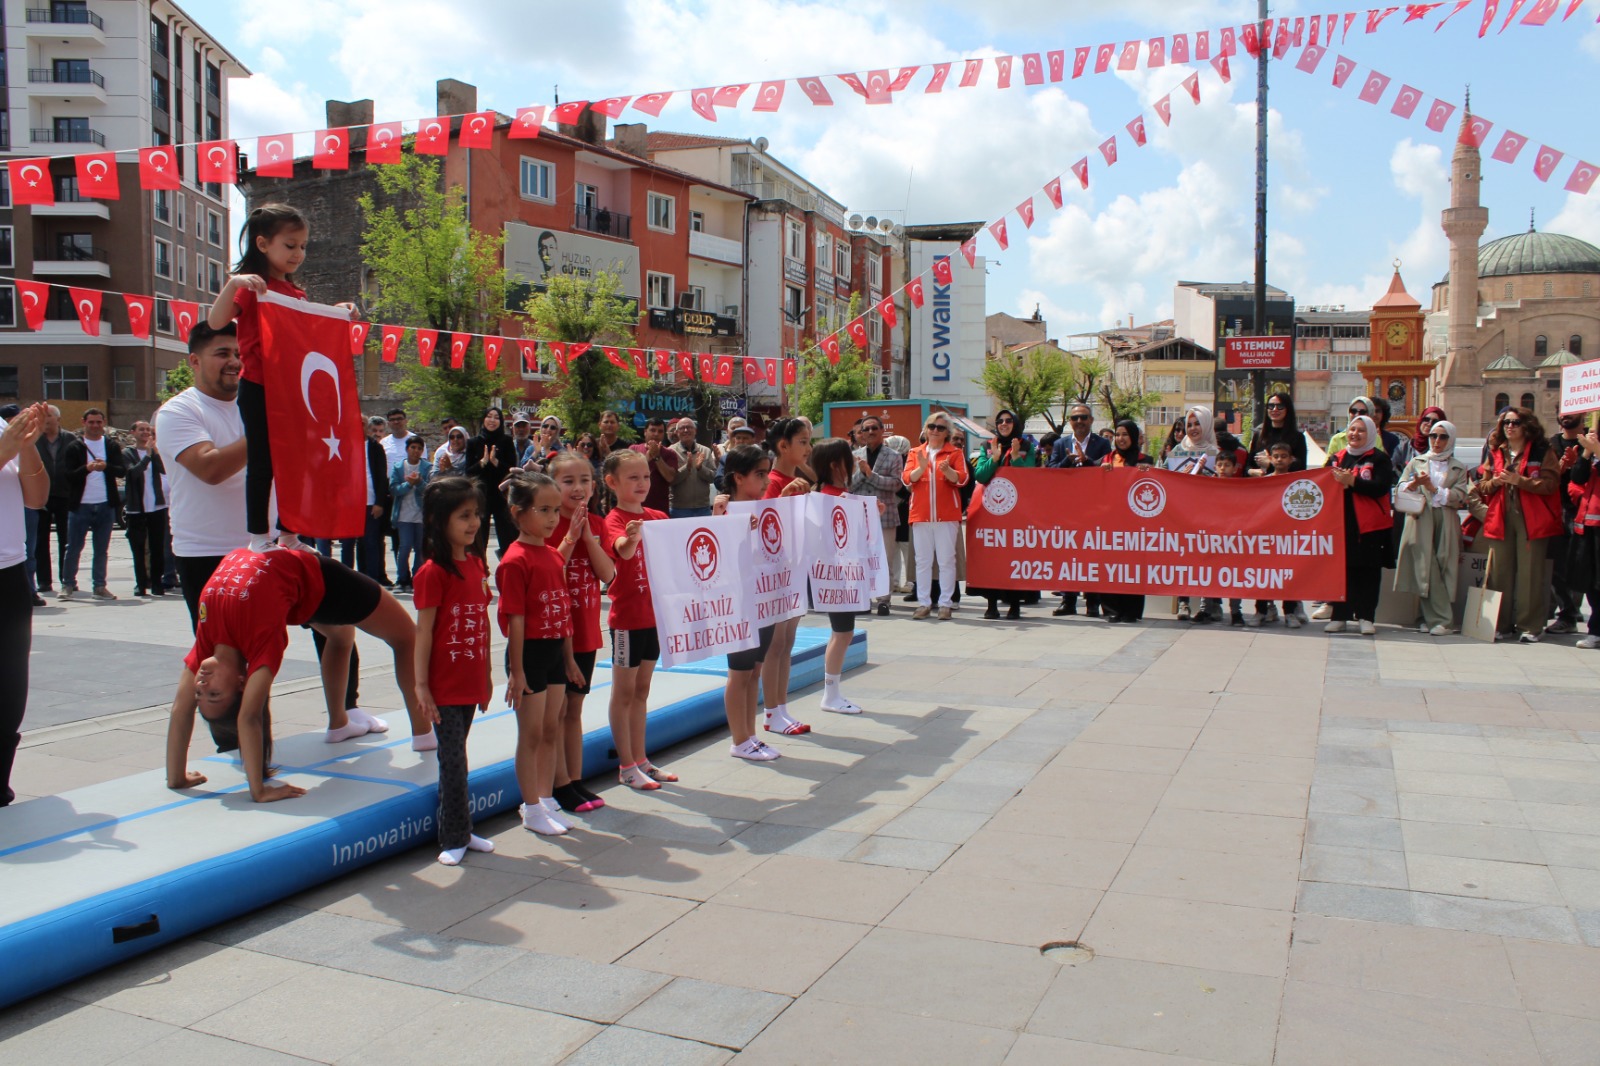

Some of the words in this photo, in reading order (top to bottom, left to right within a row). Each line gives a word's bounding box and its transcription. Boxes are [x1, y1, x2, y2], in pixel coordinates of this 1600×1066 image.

[562, 251, 591, 265] HUZUR
[1230, 341, 1242, 351] 15
[1244, 340, 1285, 351] TEMMUZ
[933, 352, 950, 382] LC
[1012, 525, 1078, 549] BÜYÜK
[1010, 560, 1053, 580] 2025
[1058, 557, 1099, 582] AİLE
[1104, 563, 1141, 584] YILI
[1147, 565, 1212, 587] KUTLU
[682, 594, 734, 624] AİLEMİZ
[332, 813, 433, 867] Innovative
